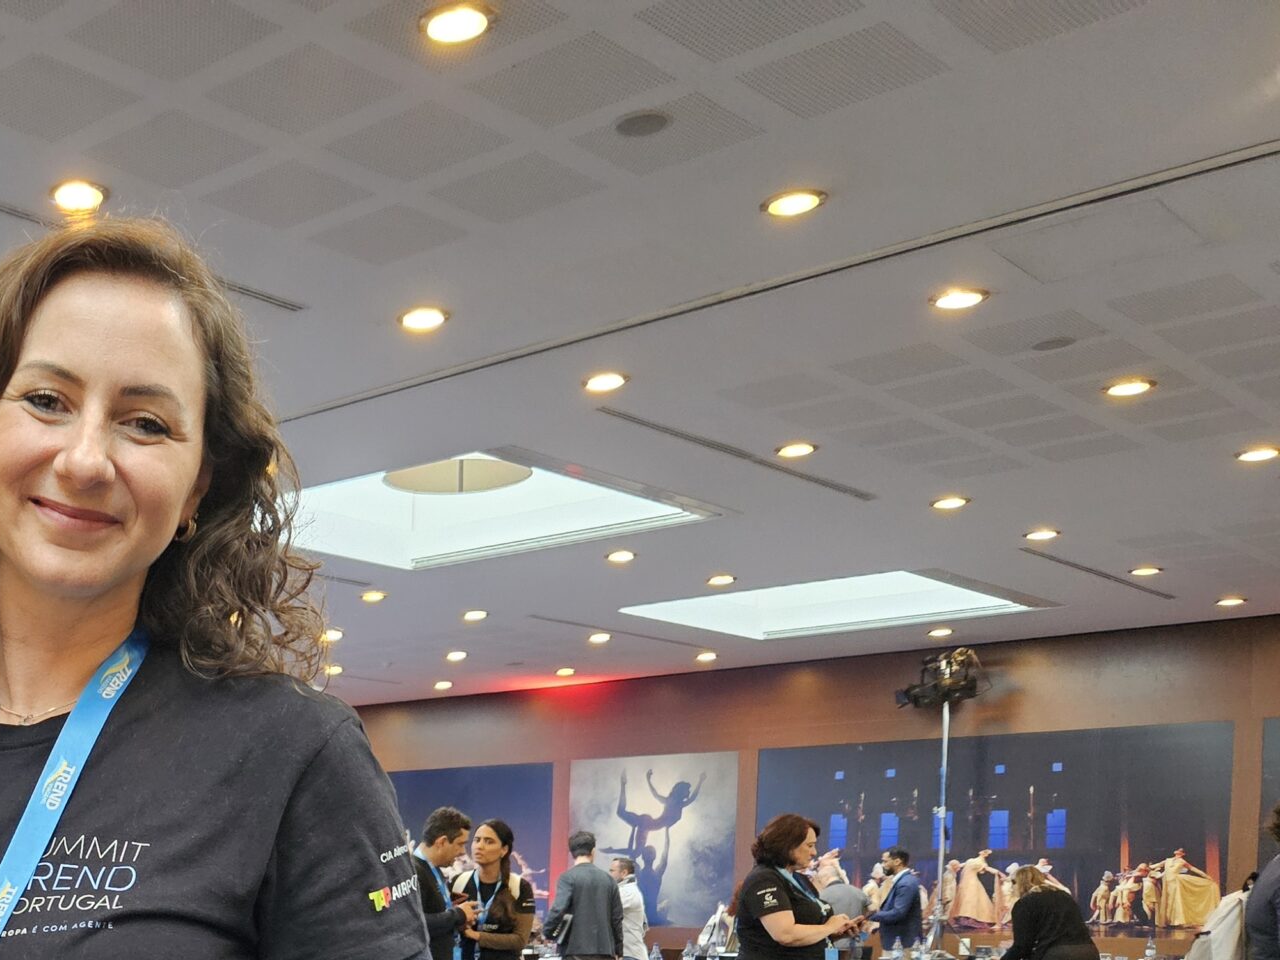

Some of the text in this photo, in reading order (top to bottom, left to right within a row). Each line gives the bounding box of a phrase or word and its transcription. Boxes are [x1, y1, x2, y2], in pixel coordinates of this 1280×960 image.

[46, 765, 76, 810] TREND
[42, 834, 151, 863] UMMIT
[26, 862, 137, 892] REND
[12, 894, 124, 915] ORTUGAL
[1, 927, 28, 938] ROPA
[42, 924, 68, 933] COM
